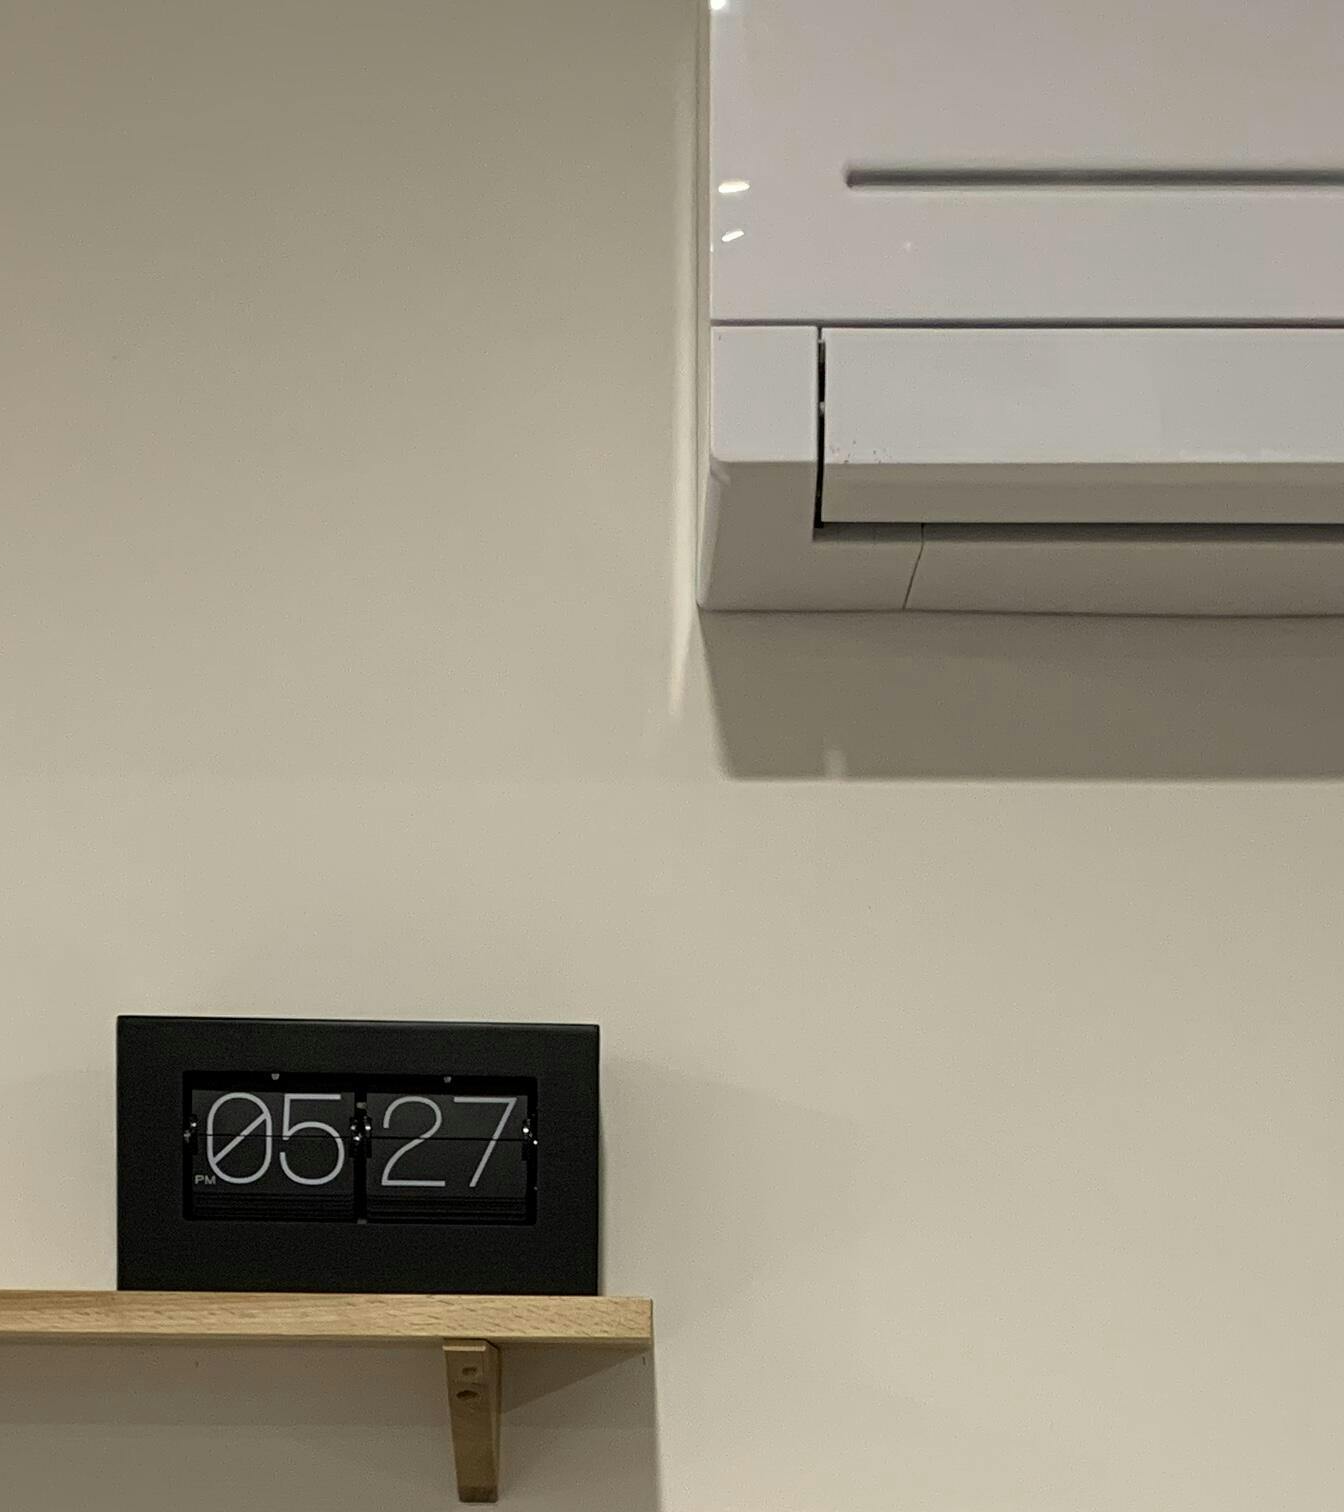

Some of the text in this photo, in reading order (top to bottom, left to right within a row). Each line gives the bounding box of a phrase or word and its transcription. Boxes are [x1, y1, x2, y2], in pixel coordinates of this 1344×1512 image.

[206, 1092, 518, 1187] 05 27
[194, 1174, 216, 1185] PM
